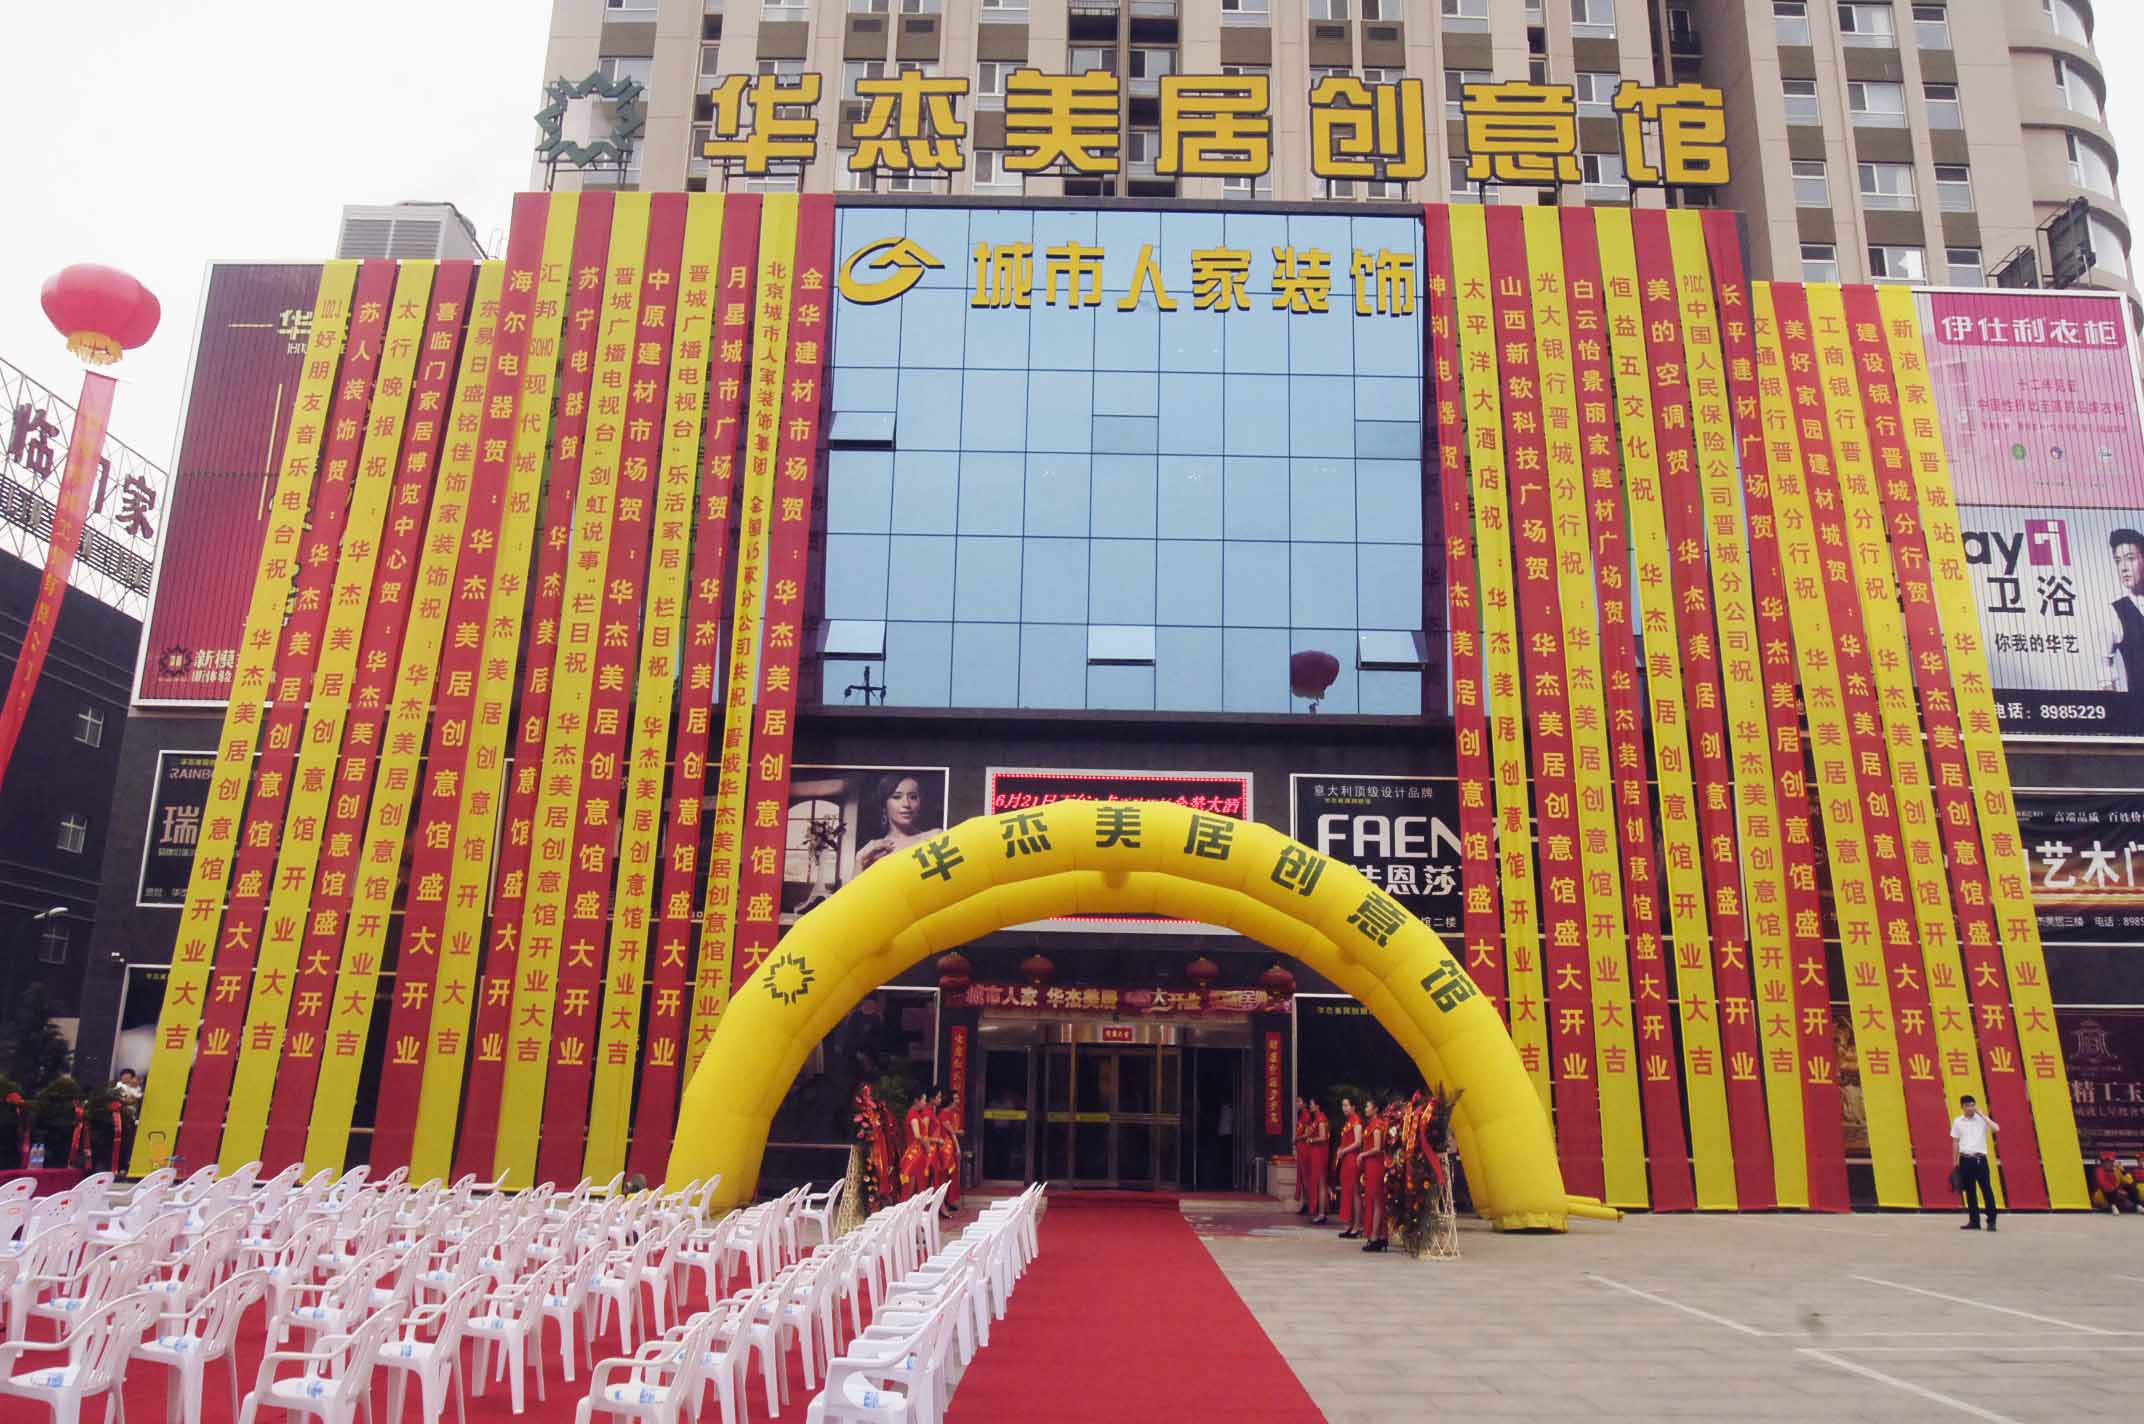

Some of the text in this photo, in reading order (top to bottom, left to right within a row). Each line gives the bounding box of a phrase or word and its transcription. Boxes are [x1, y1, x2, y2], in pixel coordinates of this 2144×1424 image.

[702, 69, 1731, 186] 华杰美居创意馆
[970, 239, 1416, 318] 城市人家装饰
[1941, 315, 2118, 345] 伊仕利衣柜
[1987, 575, 2077, 617] 卫浴
[1995, 633, 2080, 654] 你我的华艺
[911, 806, 1477, 1013] 华杰美居创意馆
